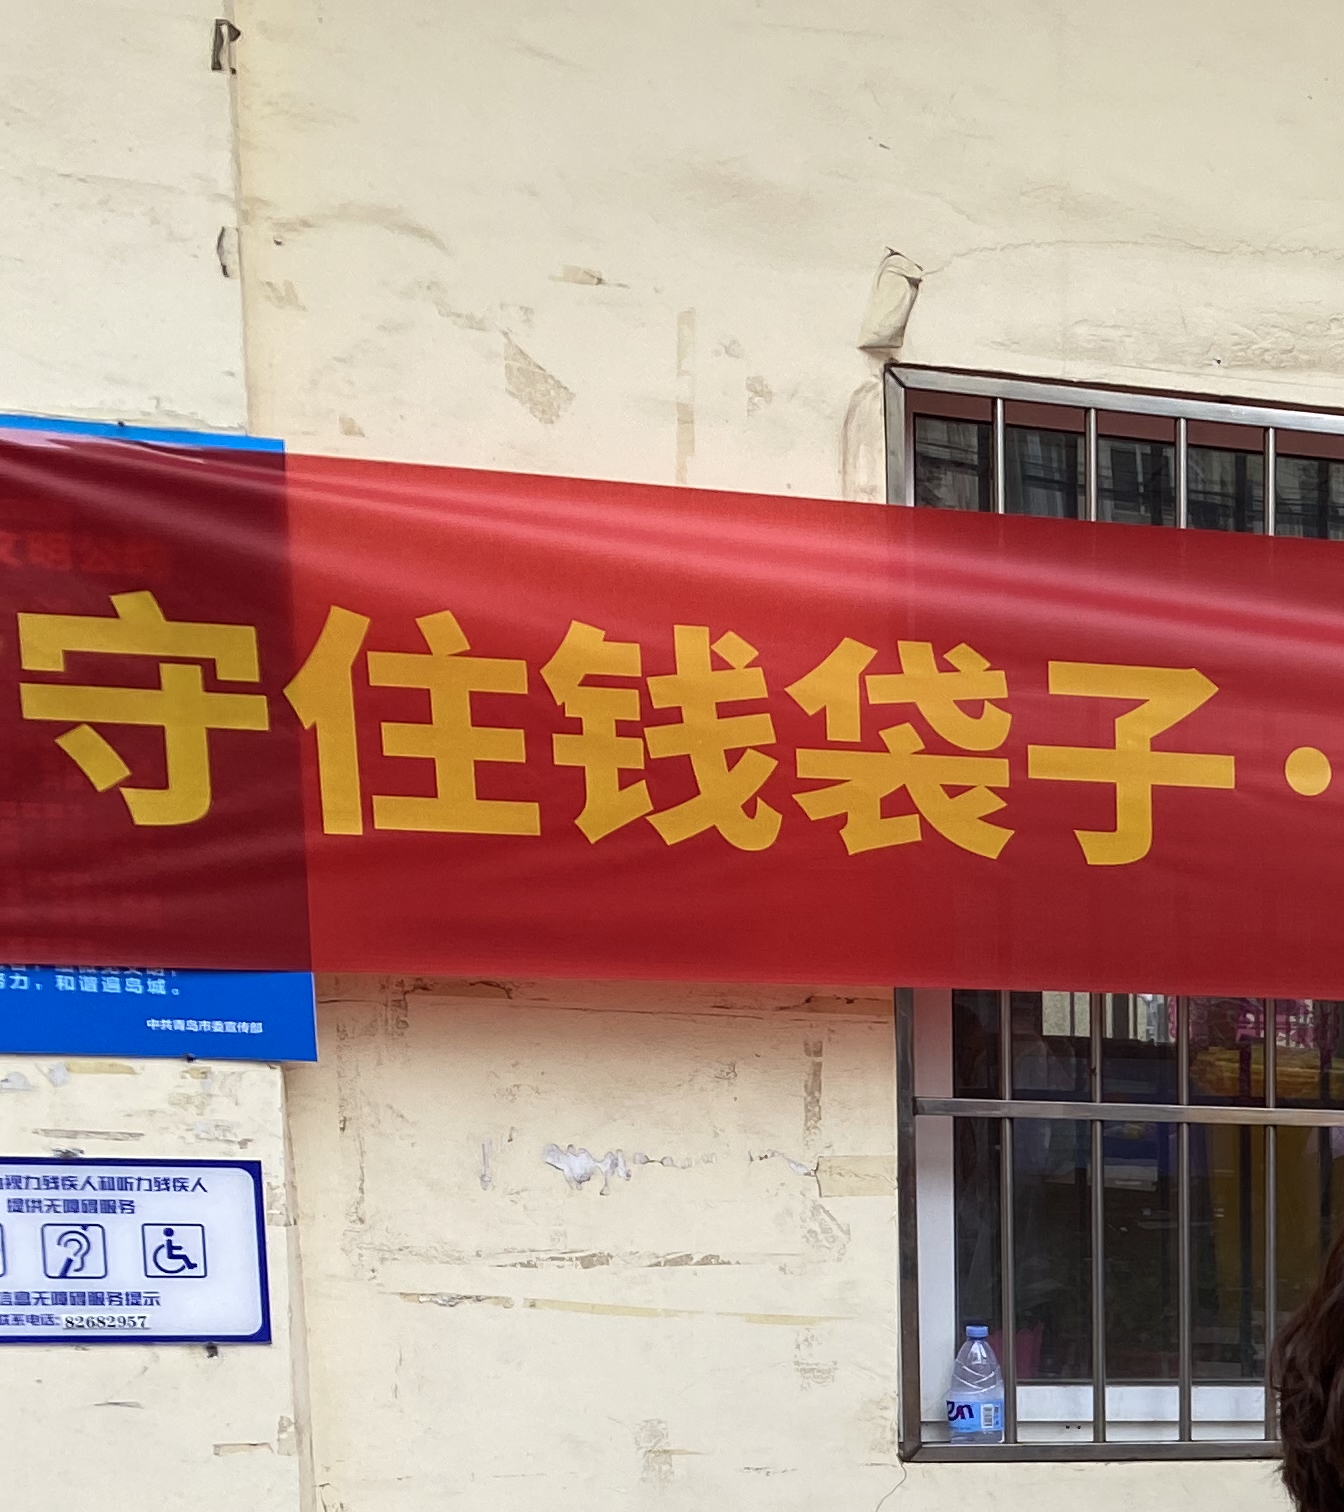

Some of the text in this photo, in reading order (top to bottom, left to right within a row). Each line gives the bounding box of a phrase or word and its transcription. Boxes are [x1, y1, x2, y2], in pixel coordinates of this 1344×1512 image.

[0, 973, 180, 996] 力，和谐遍岛城。
[147, 1019, 263, 1034] 中共青岛市委宣传部
[0, 1175, 208, 1193] 视力残疾人和听力残疾人
[7, 1198, 136, 1215] 提供无障碍服务
[65, 1315, 148, 1329] 82682957
